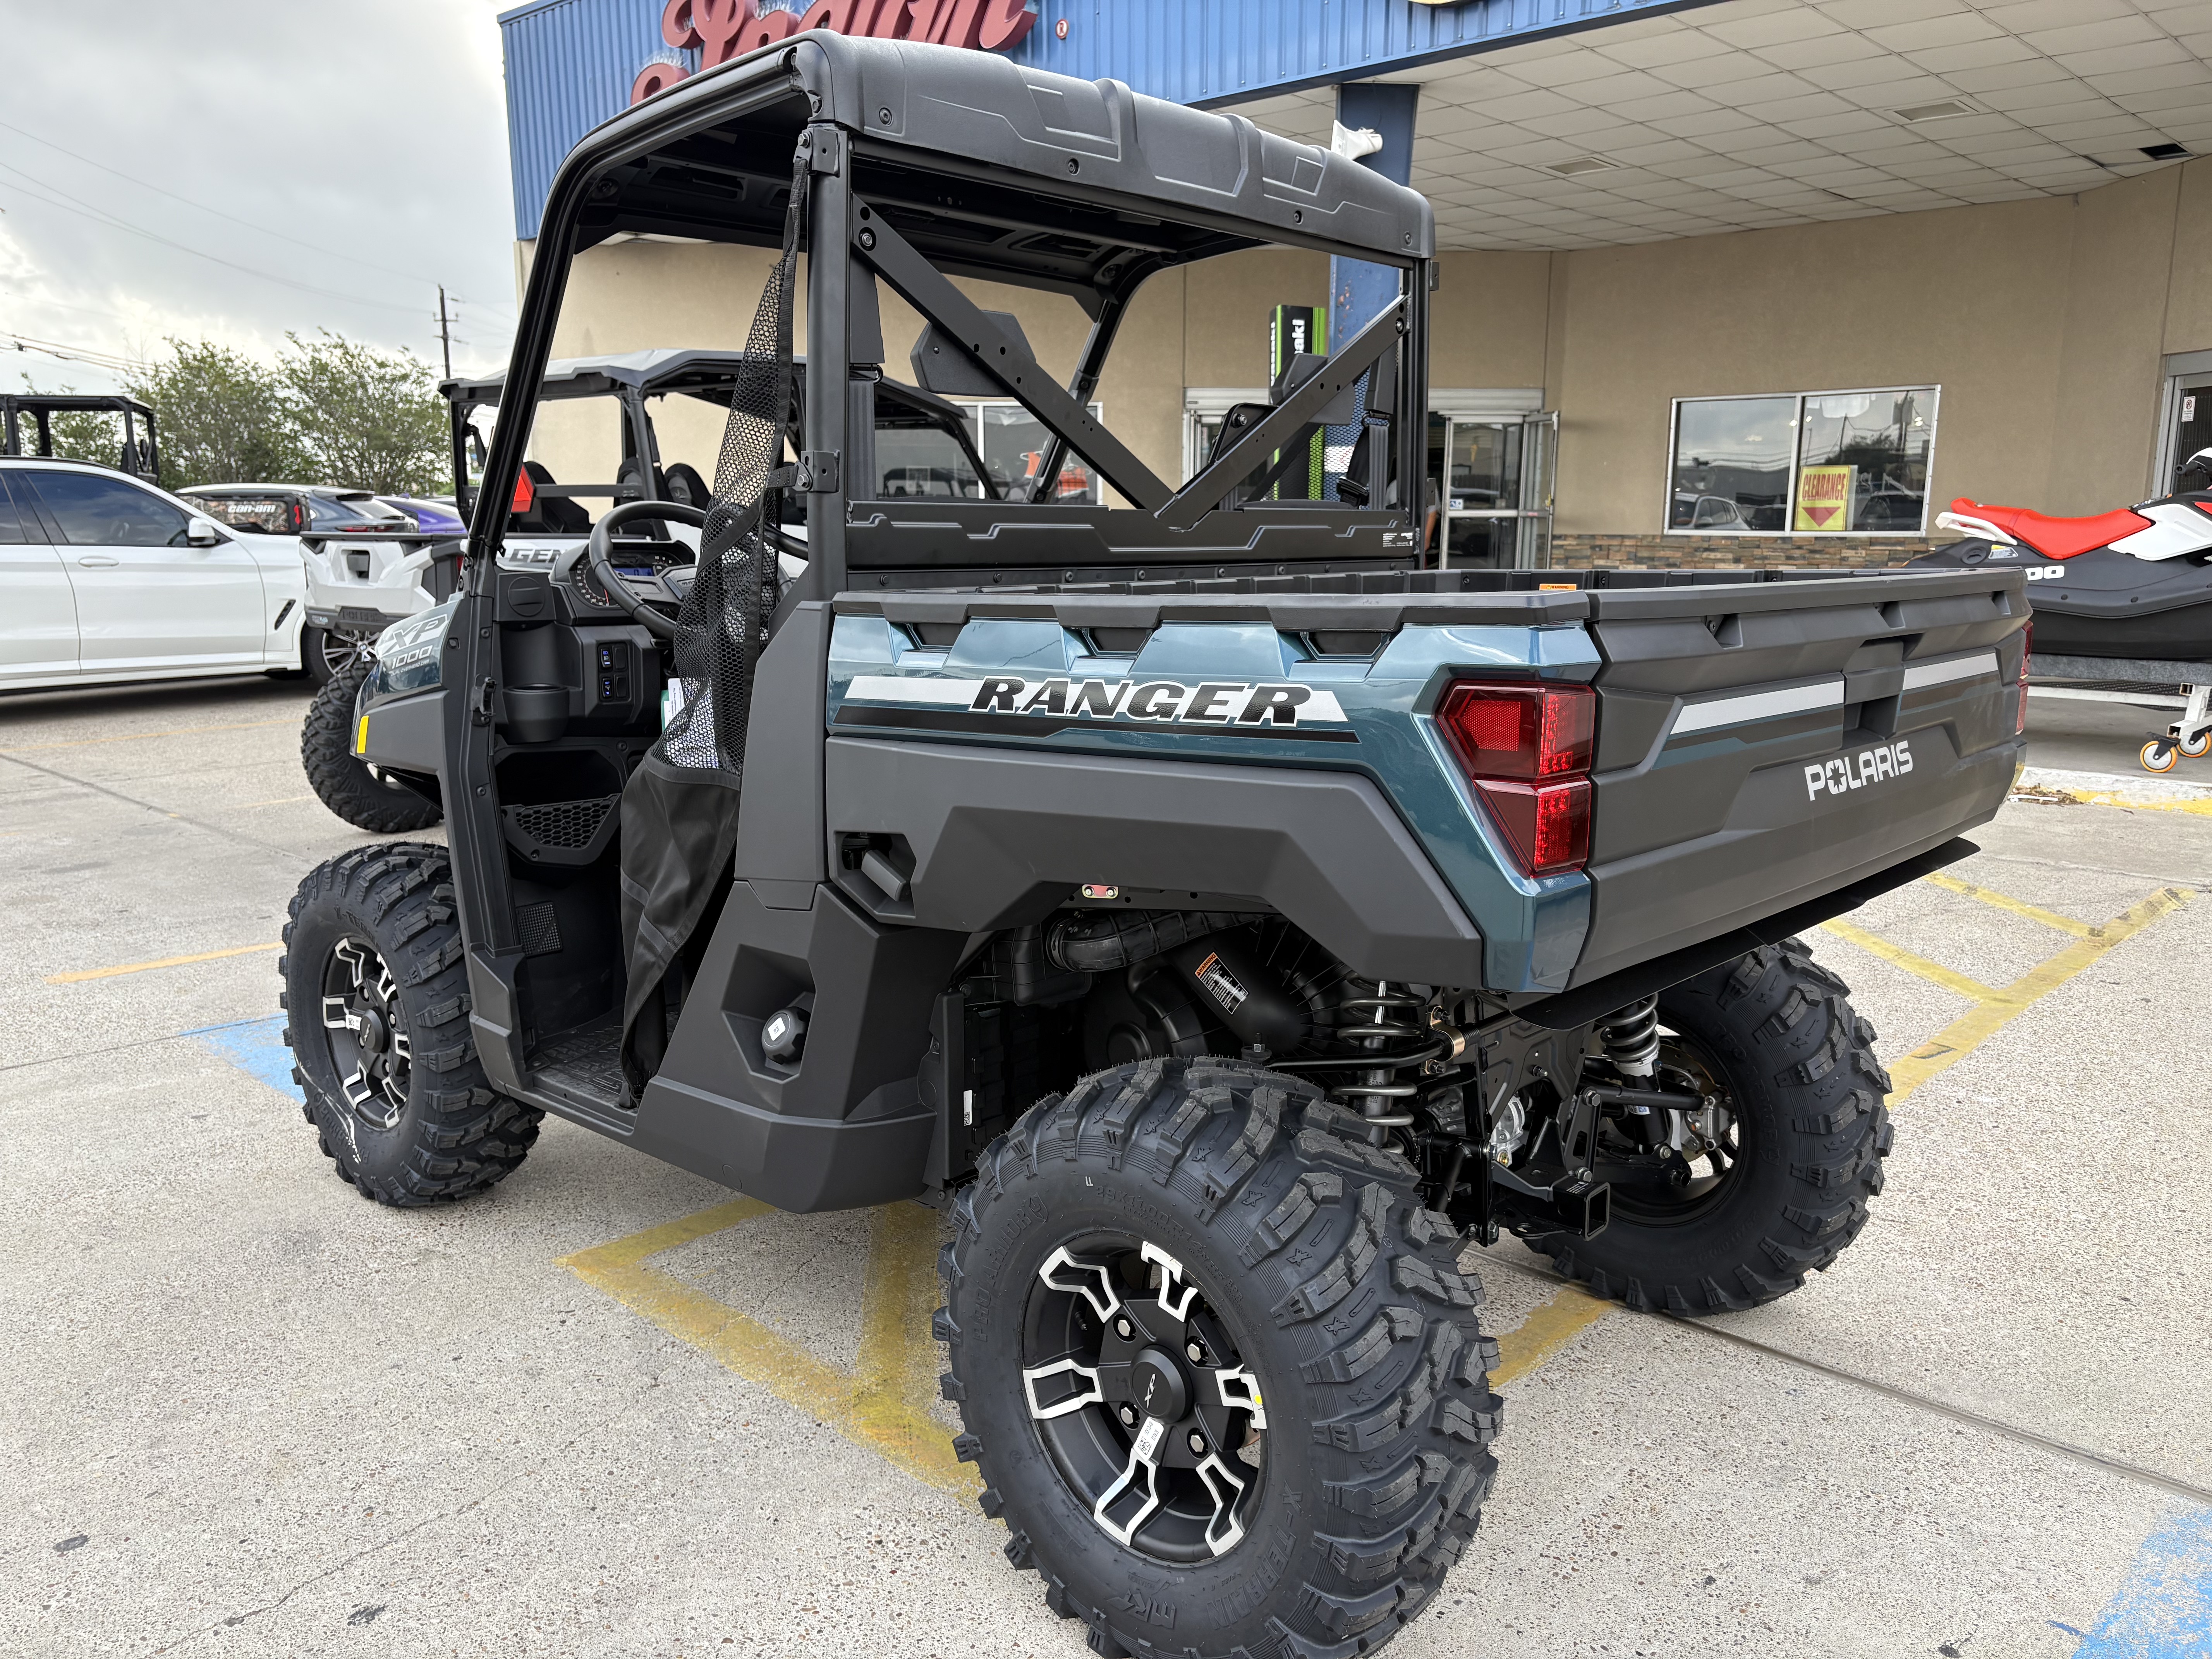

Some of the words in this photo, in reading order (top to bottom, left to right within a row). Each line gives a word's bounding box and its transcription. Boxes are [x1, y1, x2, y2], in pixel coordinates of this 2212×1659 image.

[1802, 473, 1846, 501] CLEARANCE
[382, 614, 448, 656] XP
[392, 645, 433, 669] 1000
[969, 676, 1311, 724] RANGER
[1804, 740, 1913, 801] POLARIS
[1199, 953, 1216, 974] WARNING
